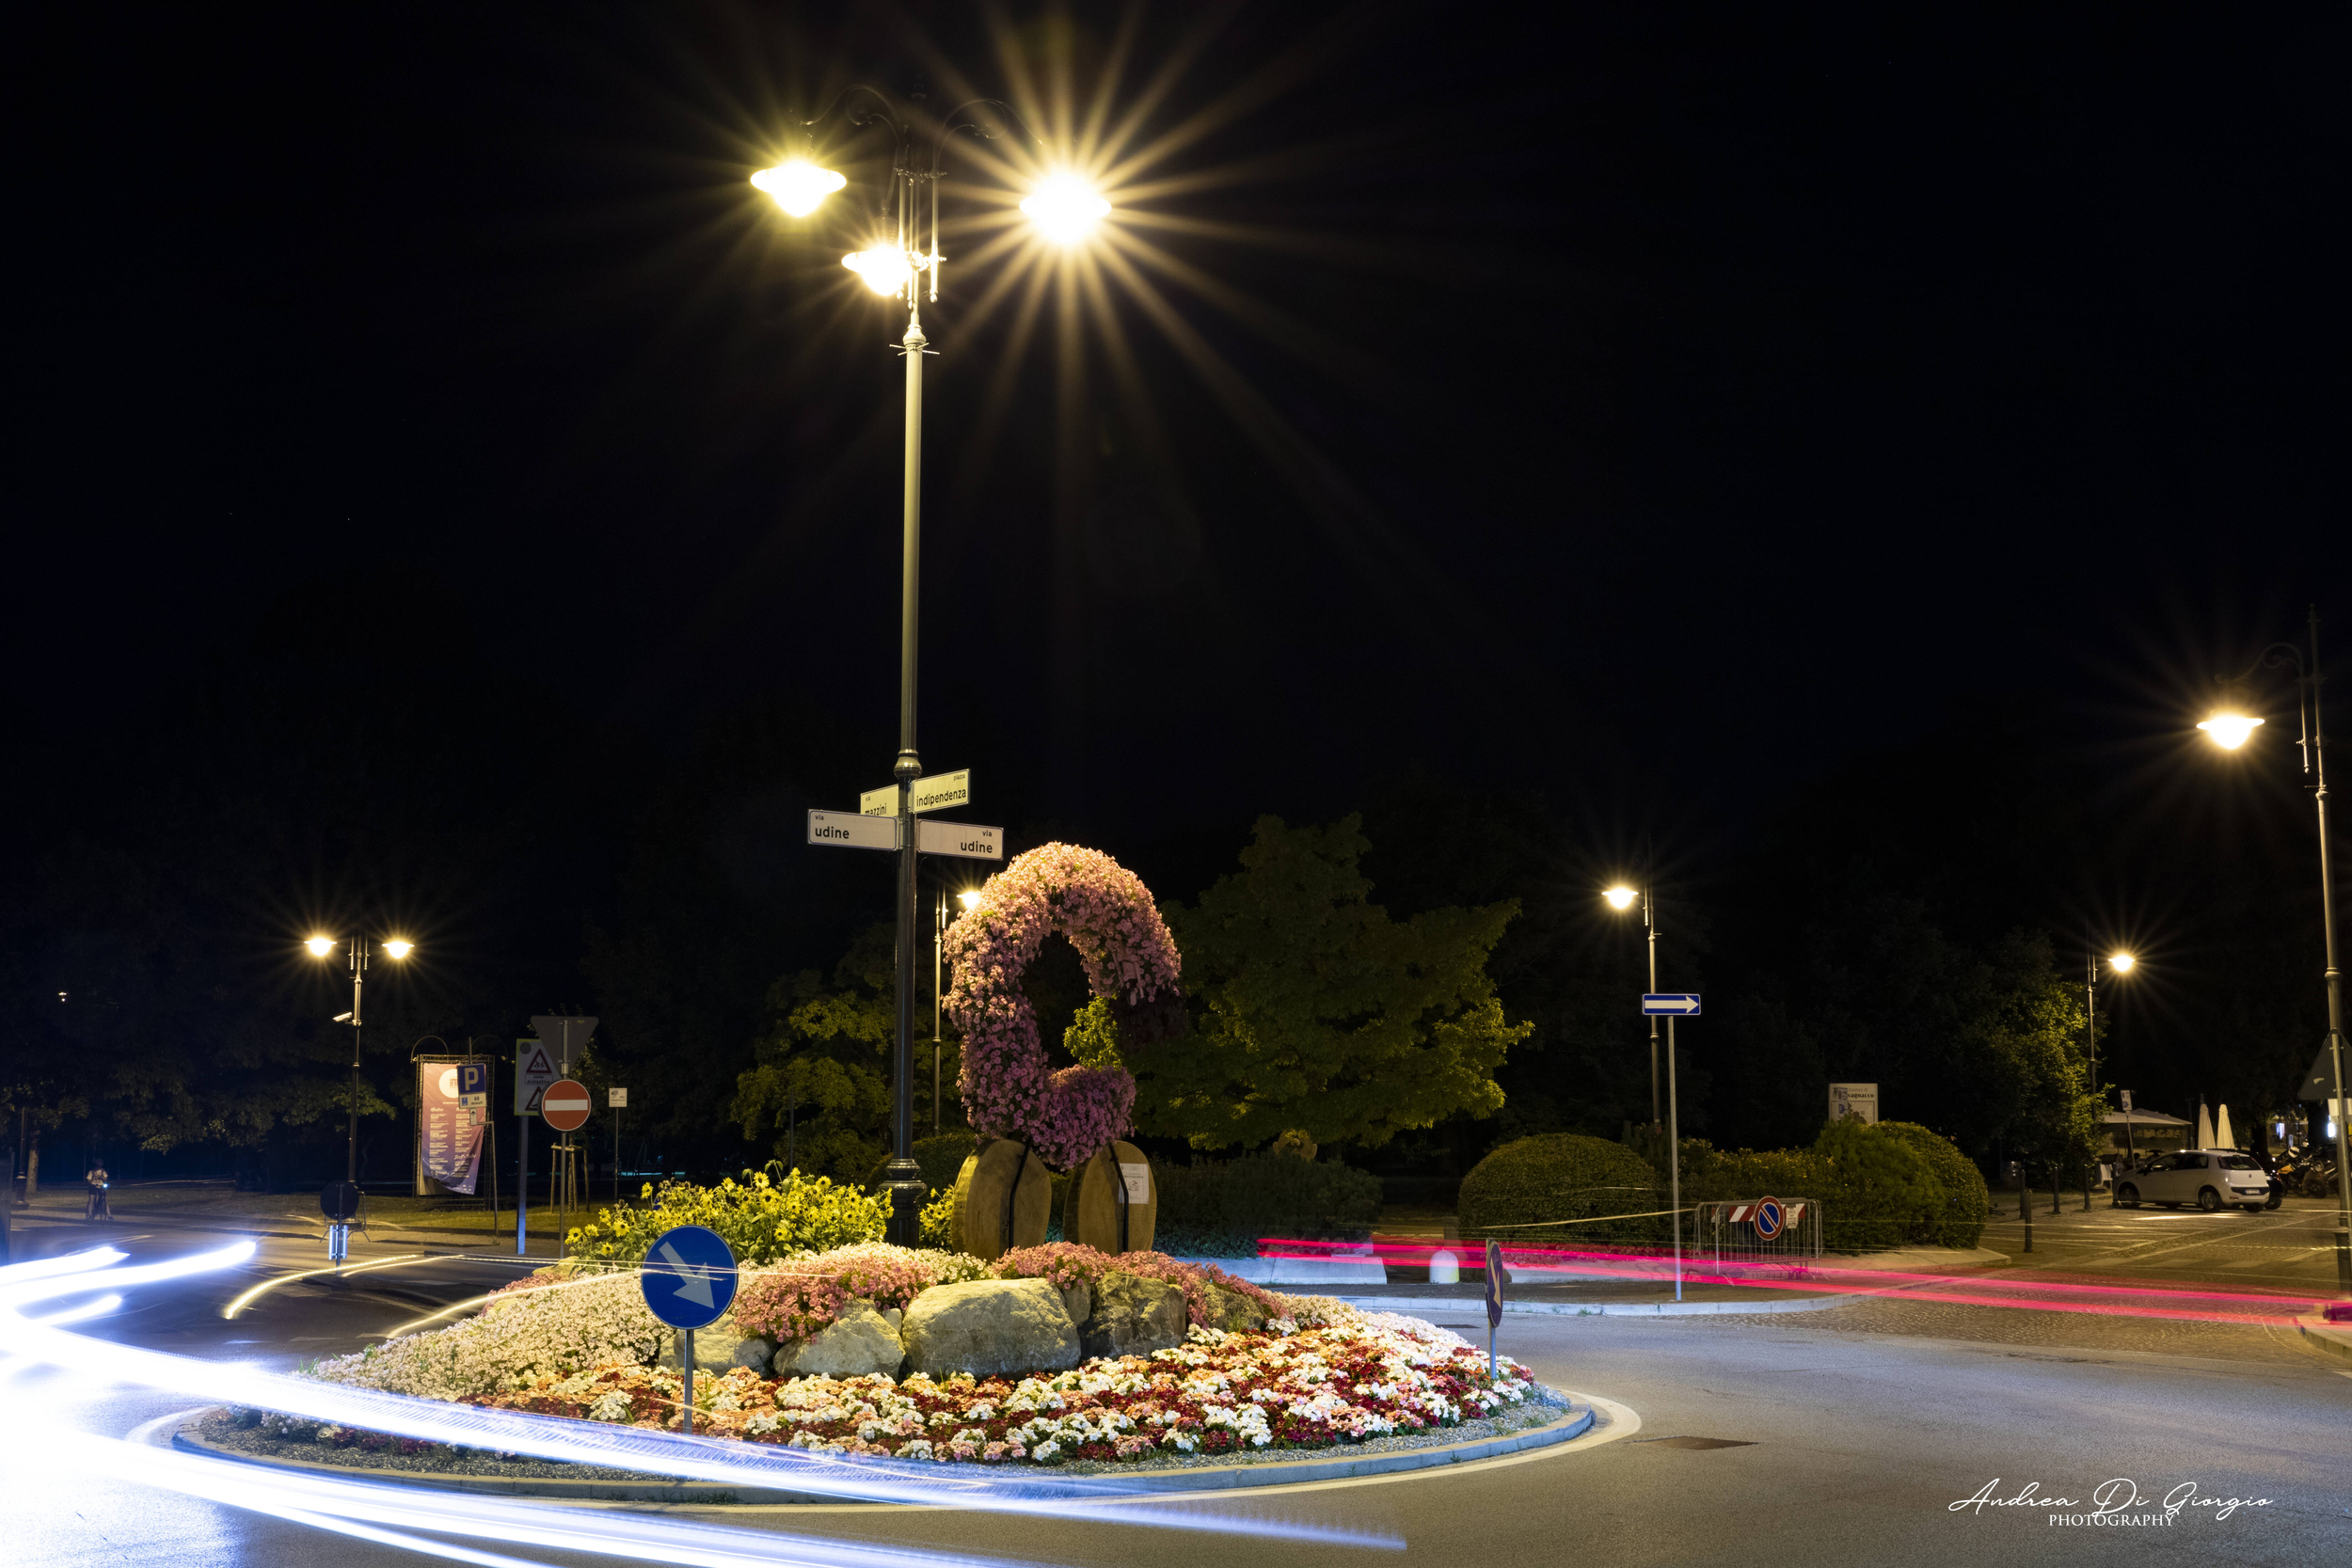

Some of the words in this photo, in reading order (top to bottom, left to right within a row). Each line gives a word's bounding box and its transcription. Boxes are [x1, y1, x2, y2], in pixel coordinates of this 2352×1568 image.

[953, 773, 965, 782] piazza
[916, 788, 966, 807] indipendenza
[865, 802, 887, 816] mazzini
[815, 826, 850, 839] udine
[961, 841, 993, 853] udine
[464, 1067, 479, 1091] P
